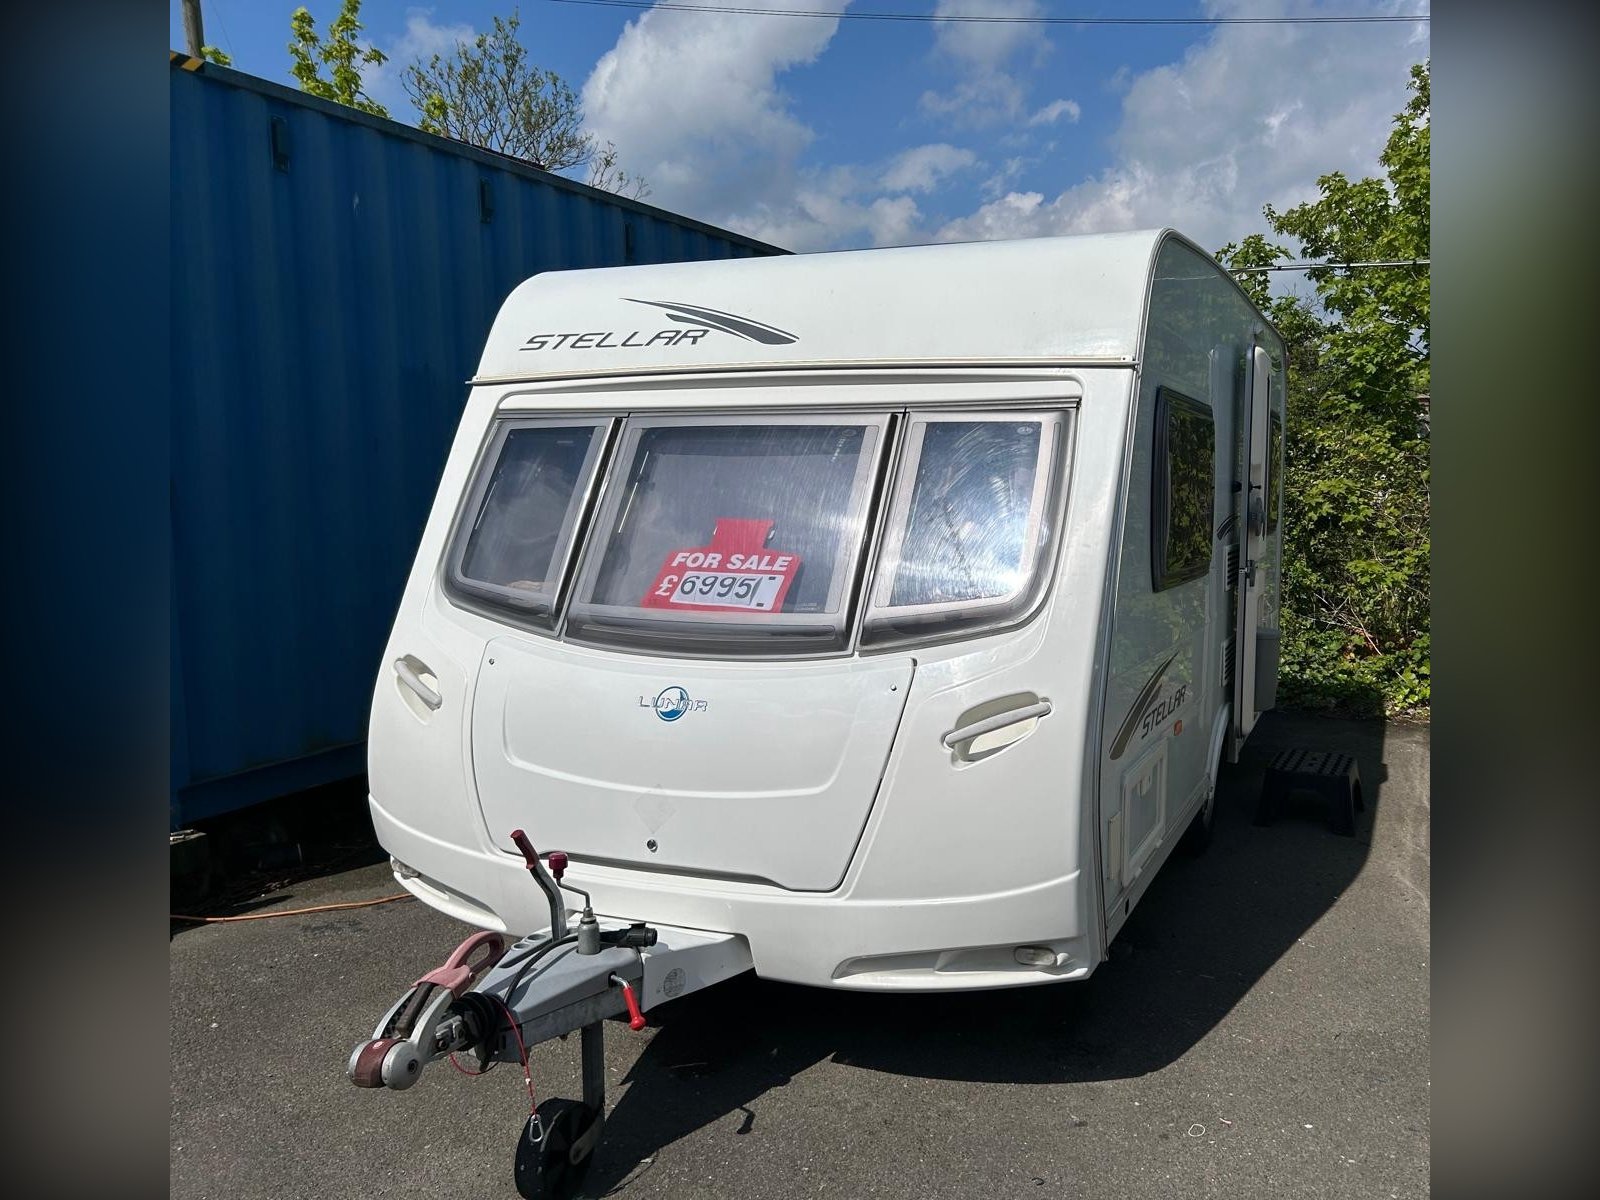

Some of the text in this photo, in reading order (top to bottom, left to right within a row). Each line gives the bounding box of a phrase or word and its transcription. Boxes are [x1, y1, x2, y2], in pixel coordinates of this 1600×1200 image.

[519, 329, 709, 351] STELLAR
[671, 552, 793, 572] FOR SALE
[639, 695, 708, 712] LUNAR
[1141, 684, 1187, 740] STELLAR
